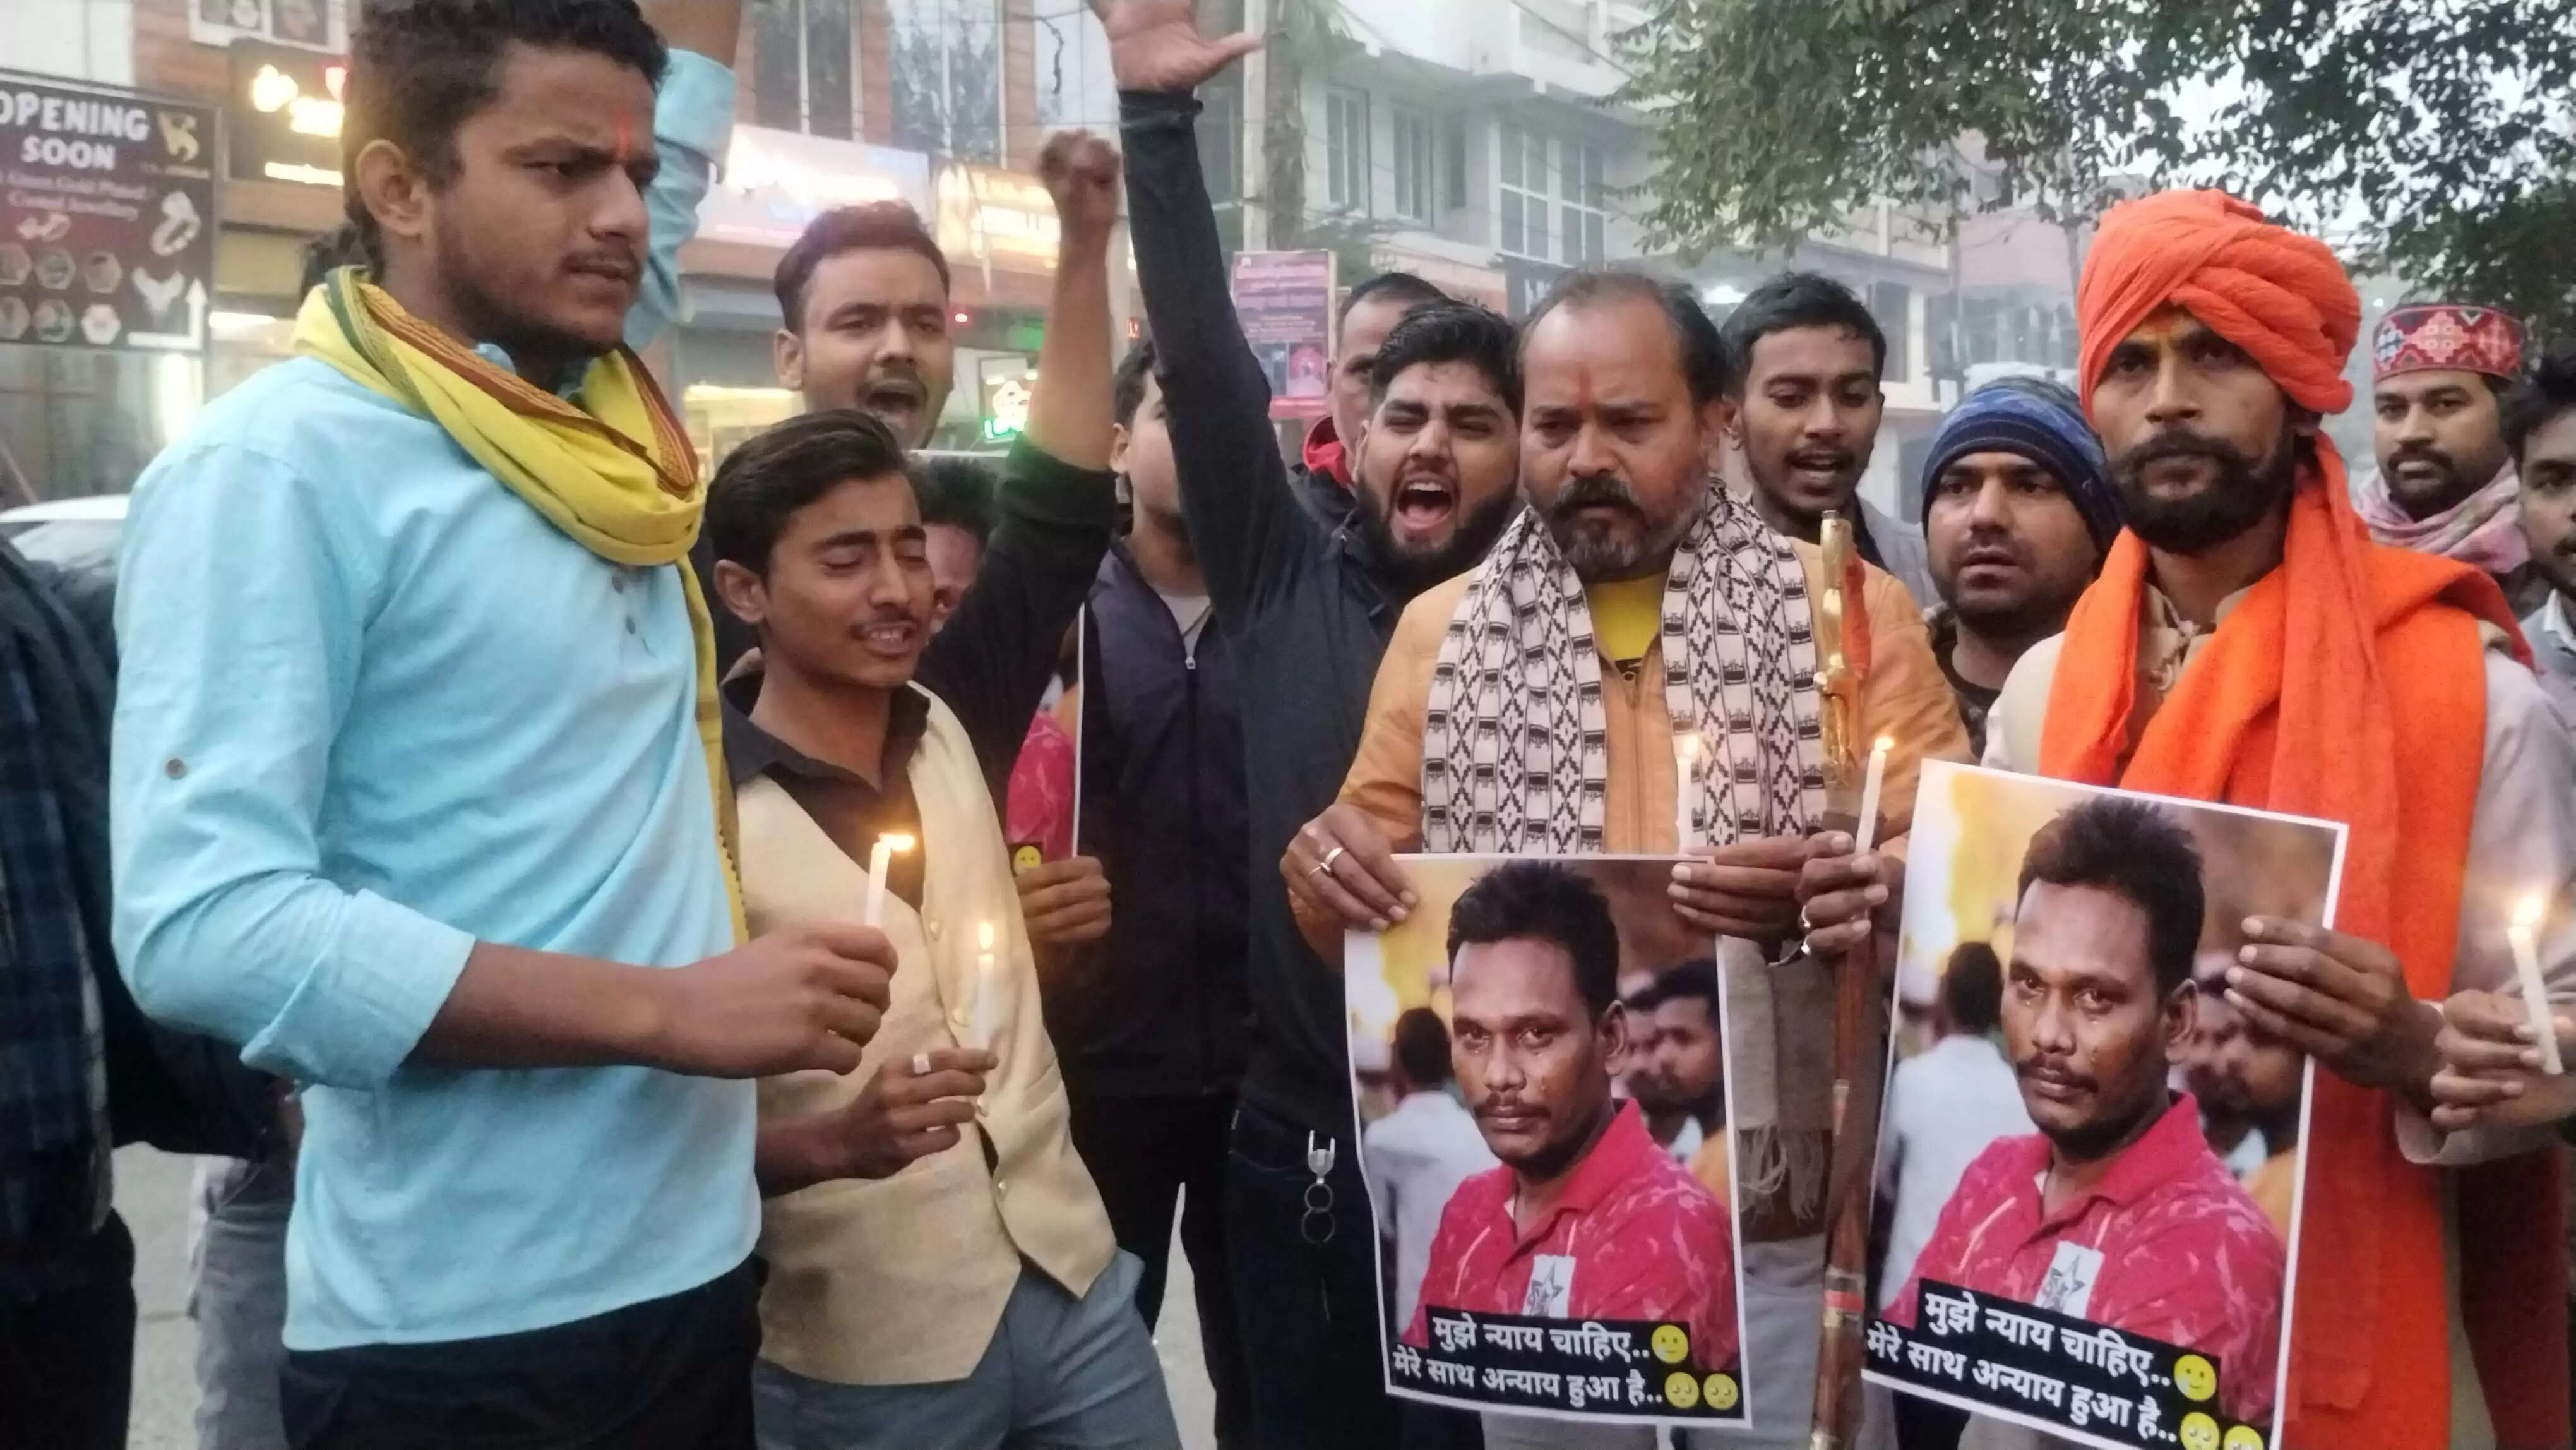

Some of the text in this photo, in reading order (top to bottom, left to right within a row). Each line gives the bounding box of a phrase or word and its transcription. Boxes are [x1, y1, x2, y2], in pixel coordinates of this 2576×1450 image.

[0, 89, 150, 141] OPENING
[20, 135, 116, 171] SOON
[1433, 1312, 1477, 1351] मुझे
[1482, 1324, 1544, 1352] न्याय
[1925, 1291, 1979, 1336] मुझे
[1985, 1307, 2055, 1352] न्याय
[1393, 1344, 1421, 1378] मेरे
[1426, 1358, 1476, 1387] साथ
[1482, 1367, 1560, 1397] अन्याय
[1566, 1375, 1620, 1407] हुआ
[1867, 1320, 1902, 1363] मेरे
[1907, 1340, 1967, 1381] साथ
[1972, 1359, 2065, 1407] अन्याय
[2070, 1384, 2133, 1427] हुआ
